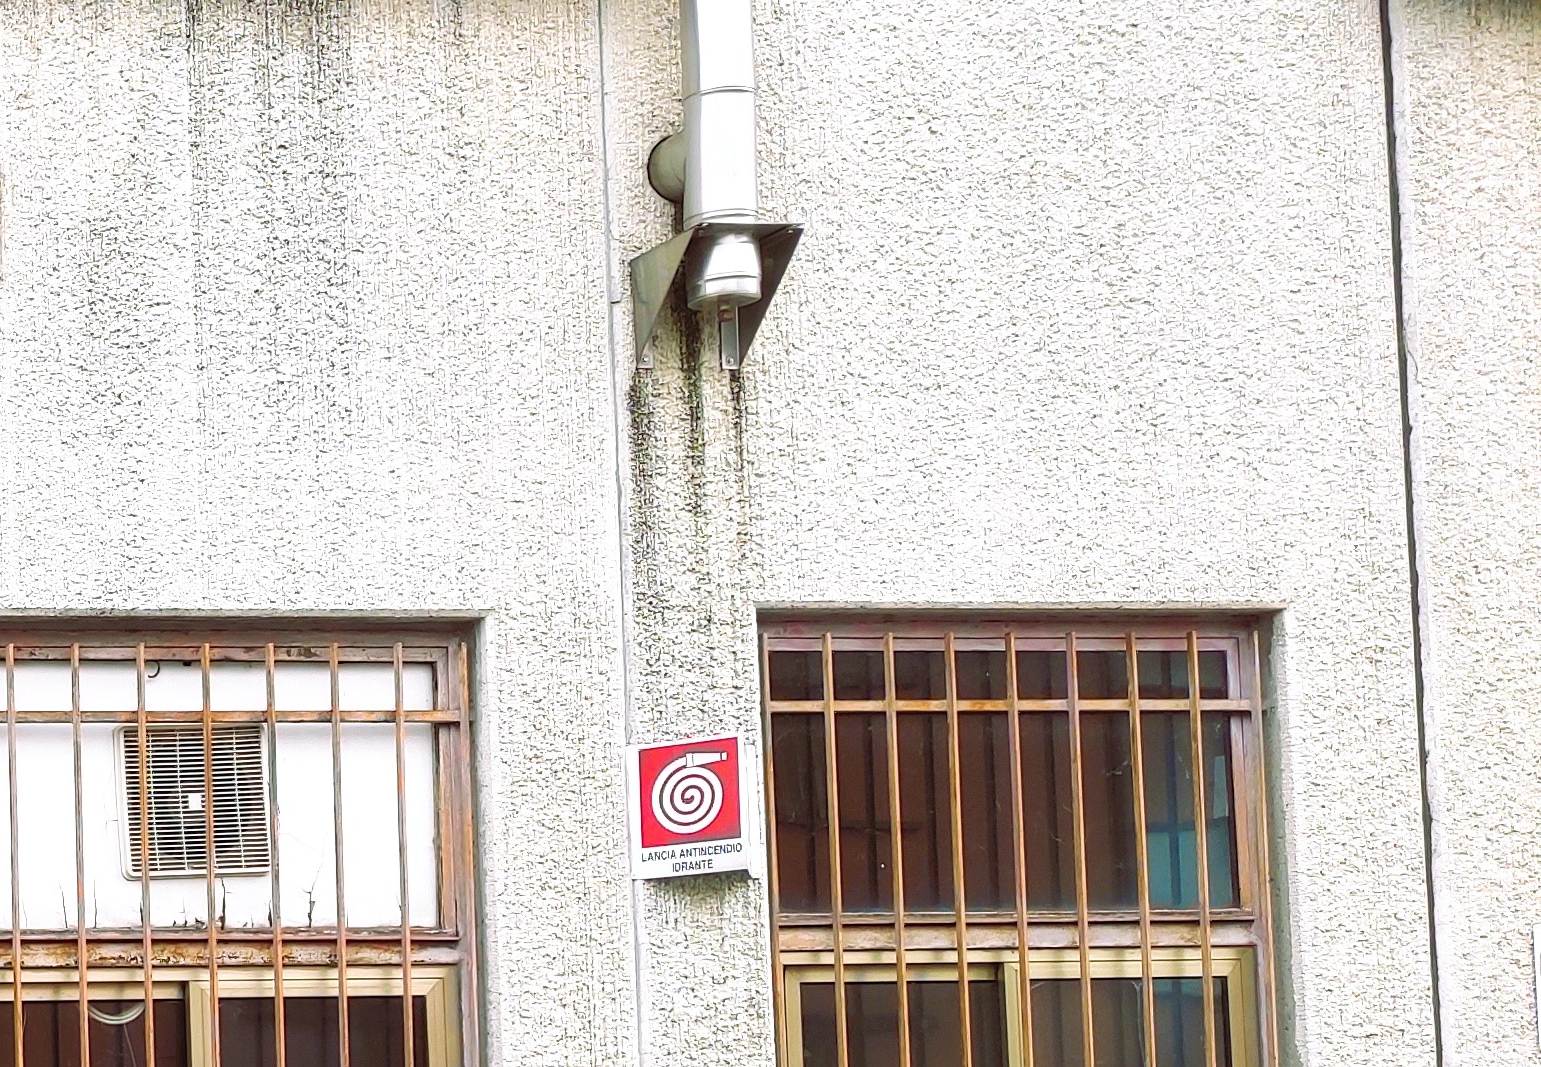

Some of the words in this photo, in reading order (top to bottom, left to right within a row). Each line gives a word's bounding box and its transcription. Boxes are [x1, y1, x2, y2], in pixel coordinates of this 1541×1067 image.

[641, 849, 677, 862] LANCIA
[679, 842, 743, 858] ANTINCENDIO
[672, 859, 714, 872] IDRANTE
